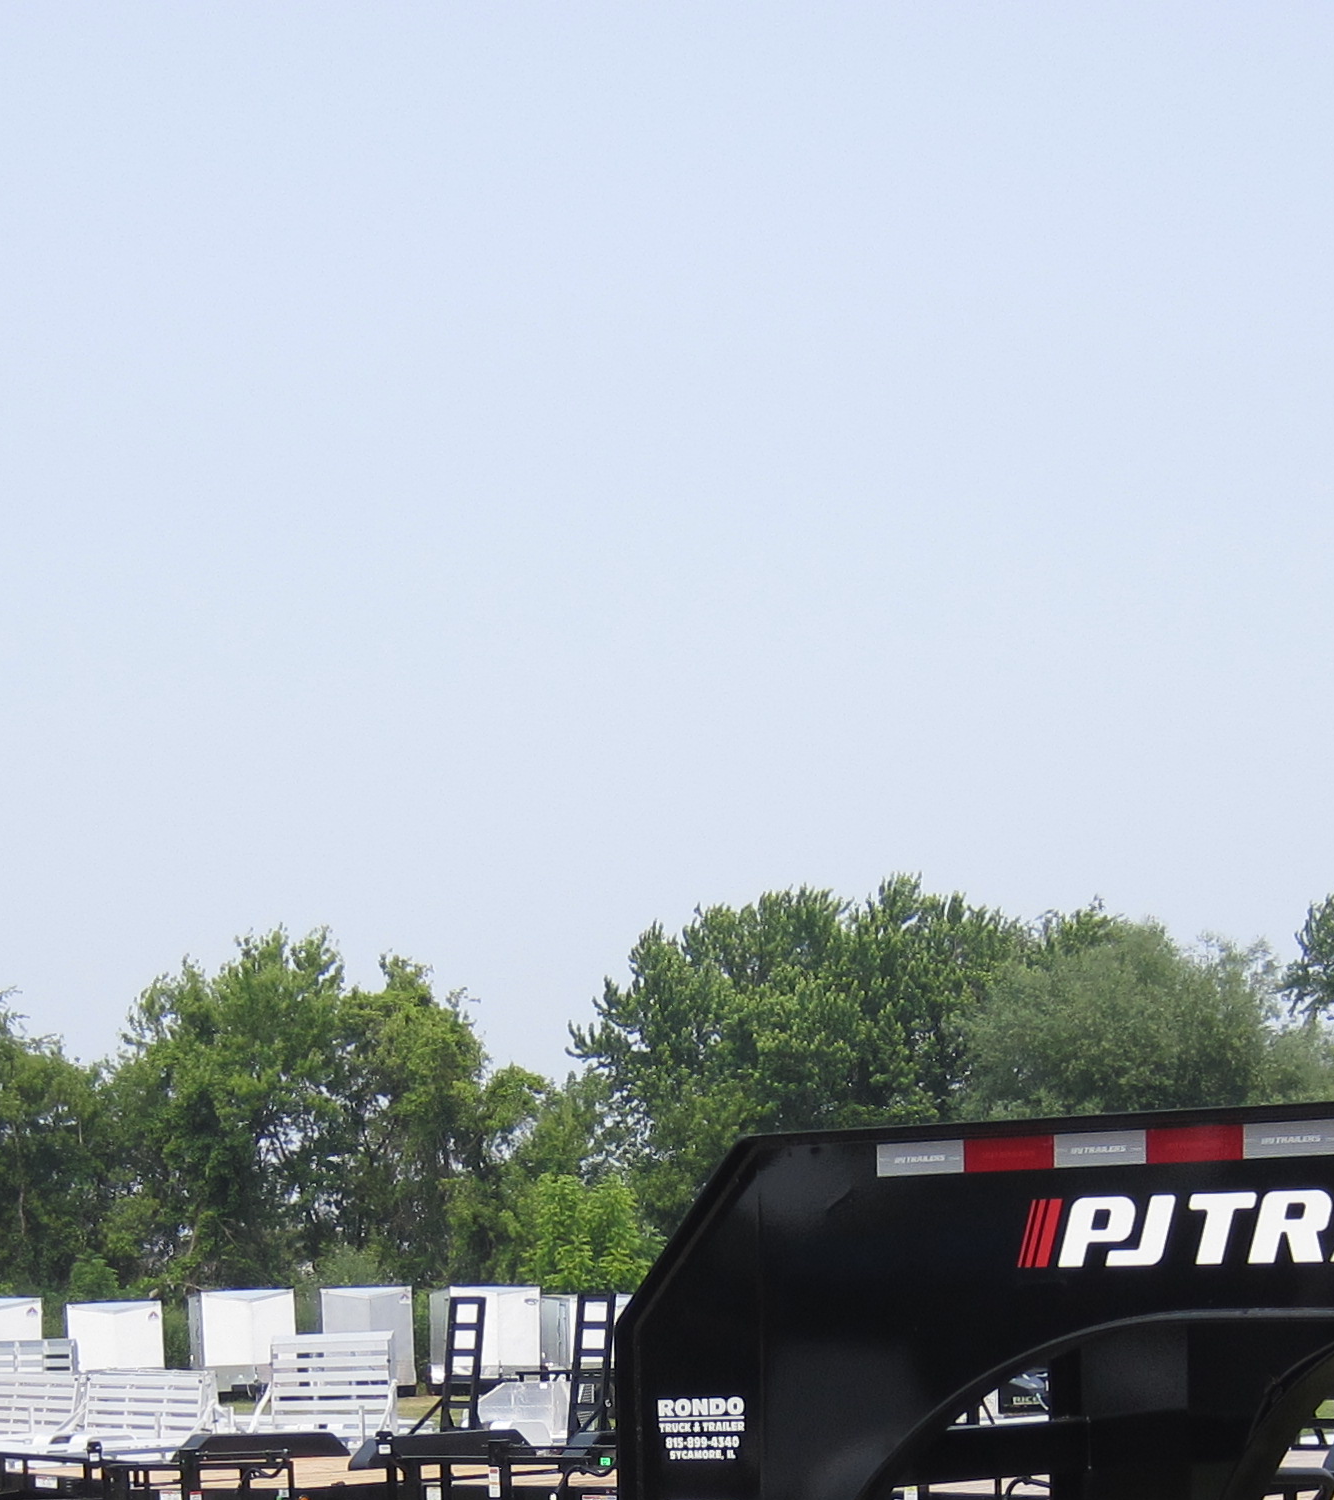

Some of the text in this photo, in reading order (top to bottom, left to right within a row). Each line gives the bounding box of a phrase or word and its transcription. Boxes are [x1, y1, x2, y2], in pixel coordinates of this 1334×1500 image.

[657, 1396, 745, 1417] RONDO
[658, 1421, 745, 1433] TRUCK & TRAILER
[665, 1435, 740, 1449] 815-899-4340
[726, 1449, 736, 1459] IL
